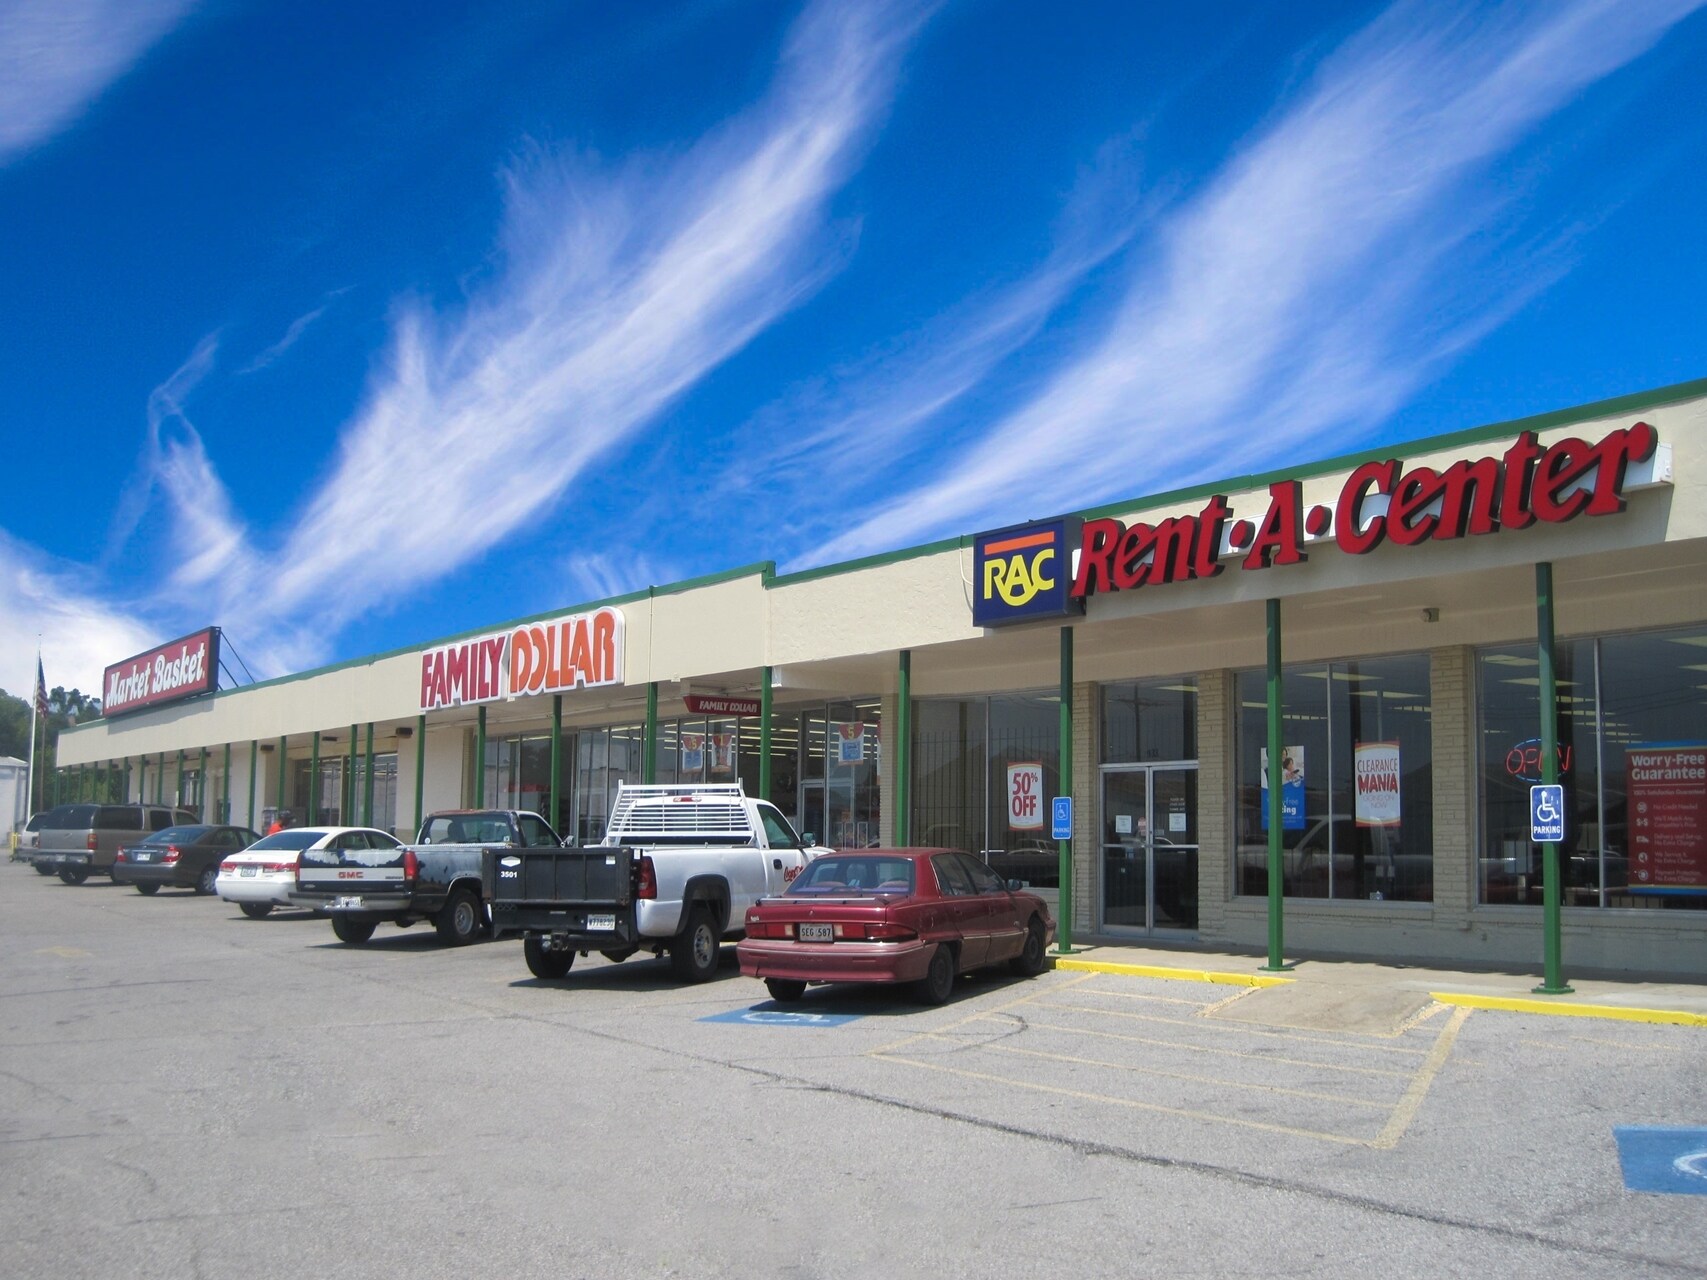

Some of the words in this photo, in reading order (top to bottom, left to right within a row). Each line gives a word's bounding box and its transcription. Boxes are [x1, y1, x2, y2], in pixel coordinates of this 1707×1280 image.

[983, 548, 1055, 607] RAC
[420, 635, 506, 708] FAMILY
[509, 610, 616, 694] DOLLAR
[106, 662, 151, 709] Market
[152, 642, 205, 693] Basket
[699, 700, 728, 711] FAMILY
[729, 702, 758, 713] DOLLAR
[1357, 758, 1398, 773] CLEARANCE
[1631, 753, 1706, 767] Worry-Free
[1631, 766, 1706, 781] Guarantee
[1012, 772, 1038, 795] 50%
[1357, 772, 1399, 796] MANIA
[1012, 795, 1037, 817] OFF
[1370, 801, 1387, 809] NOW
[1533, 825, 1561, 834] PARKING
[338, 871, 364, 879] GMC
[801, 927, 814, 937] SEG
[818, 927, 831, 937] 587
